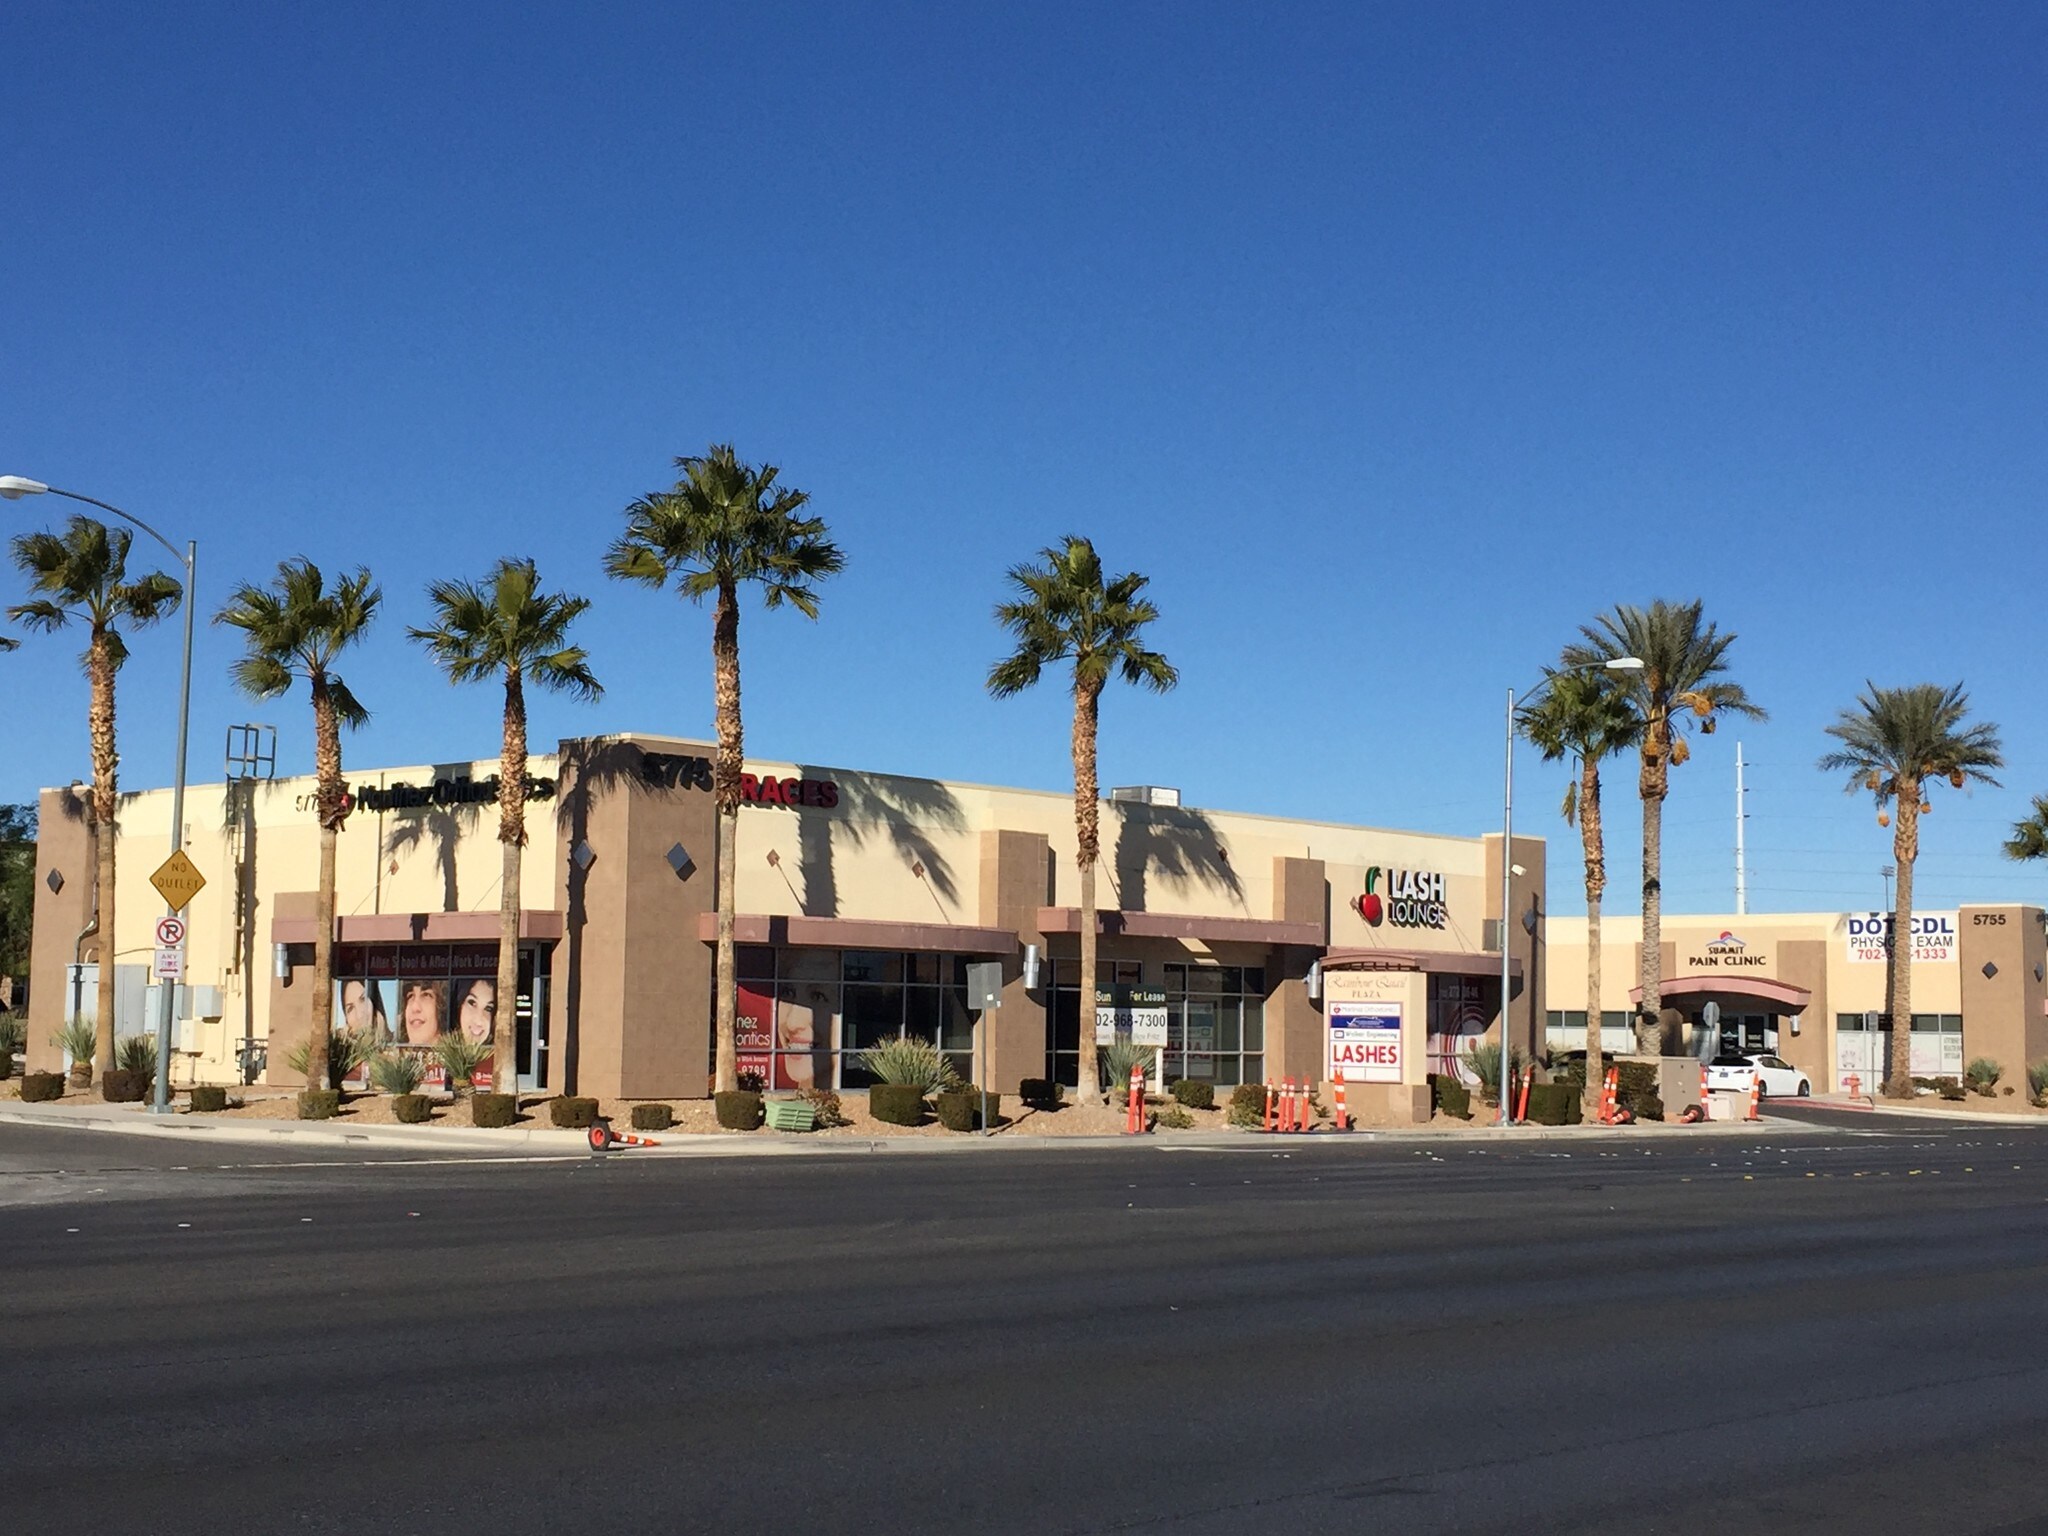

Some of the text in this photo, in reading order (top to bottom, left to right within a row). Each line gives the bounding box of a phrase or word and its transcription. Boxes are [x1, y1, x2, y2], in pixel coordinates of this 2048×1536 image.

[741, 773, 838, 808] RACES
[171, 862, 187, 873] NO
[158, 877, 198, 890] OUTLET
[1388, 868, 1445, 902] LASH
[1388, 900, 1446, 926] LOUNGE
[1973, 914, 2006, 925] 5755
[1851, 936, 1953, 948] PHYSIC EXAM
[1708, 946, 1744, 955] SUMMIT
[1857, 948, 1947, 960] 702-3-1333
[392, 955, 419, 969] Shool
[474, 953, 499, 968] Brace
[1689, 956, 1766, 966] PAIN CLINIC
[1096, 990, 1165, 1002] Sun For Lease
[1352, 990, 1381, 998] PLAZA
[736, 1016, 758, 1029] nez
[1096, 1013, 1166, 1027] 02-968-7300
[735, 1031, 771, 1046] ontics
[1333, 1044, 1397, 1064] LASHES
